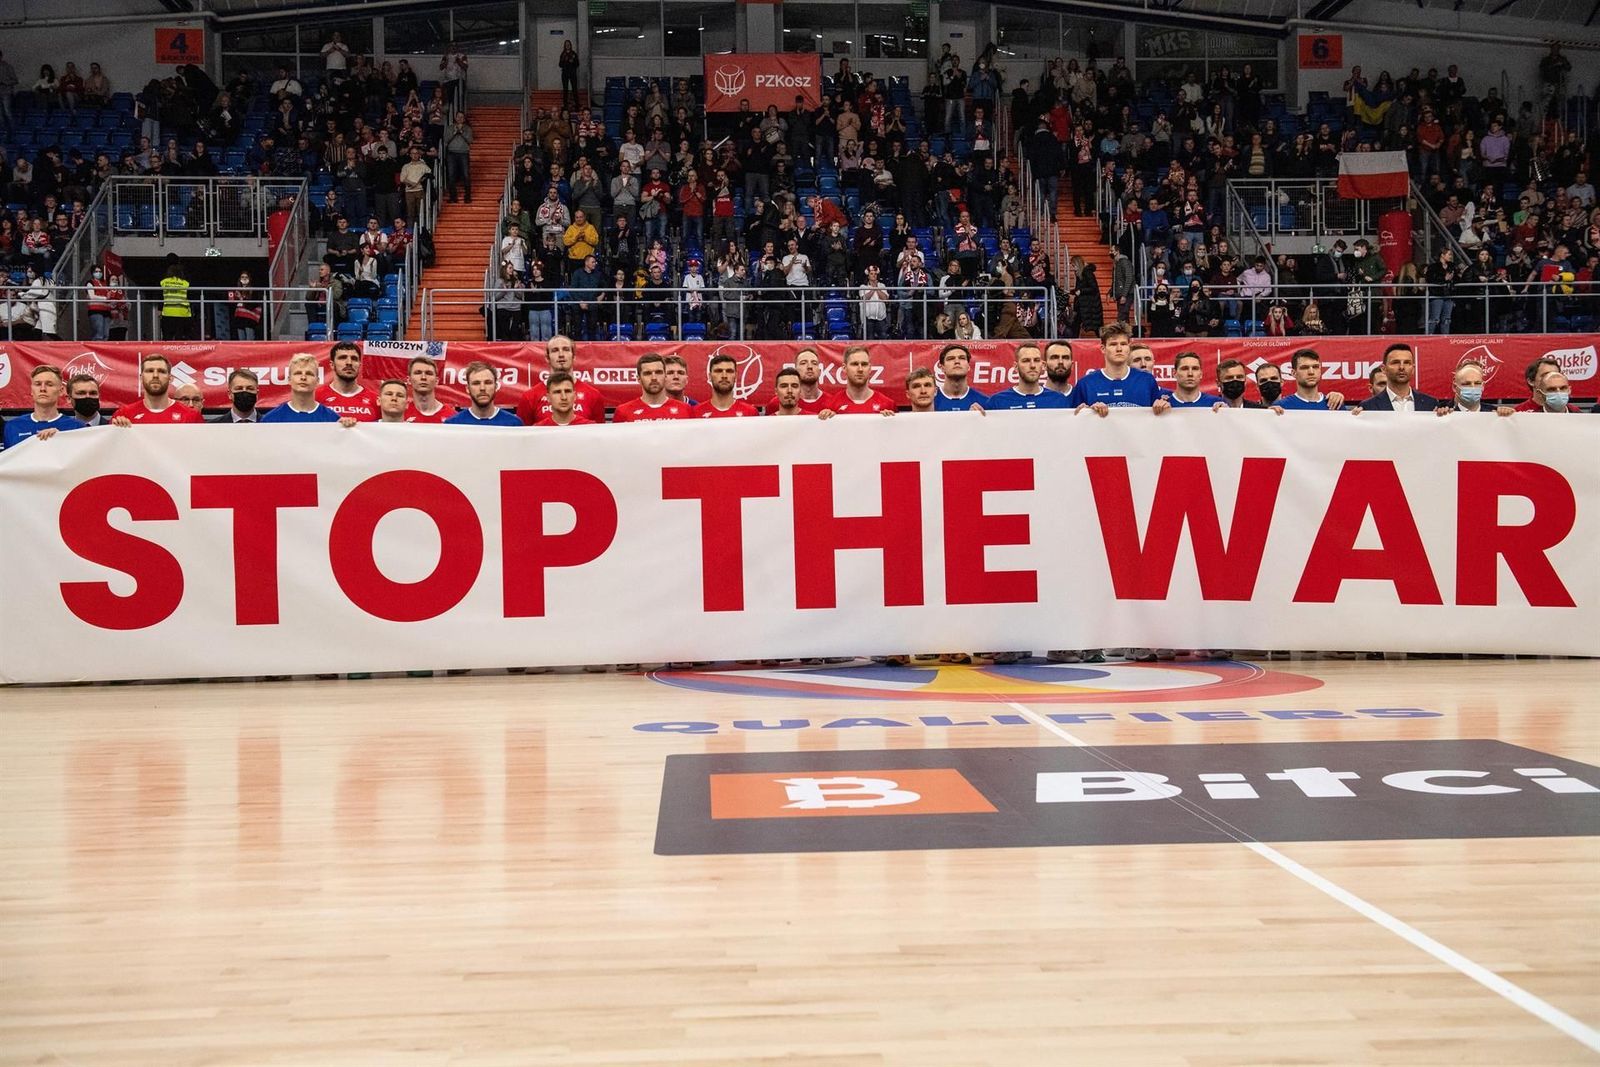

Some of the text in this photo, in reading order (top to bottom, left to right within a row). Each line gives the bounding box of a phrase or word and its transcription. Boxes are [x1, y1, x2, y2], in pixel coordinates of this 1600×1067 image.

[170, 32, 188, 54] 4
[1312, 38, 1329, 59] 6
[368, 339, 423, 351] KROTOSZYN
[67, 362, 96, 379] Polski
[597, 370, 637, 383] ORLE
[60, 456, 1576, 630] STOP THE WAR
[632, 708, 1444, 734] QUALIFIERS
